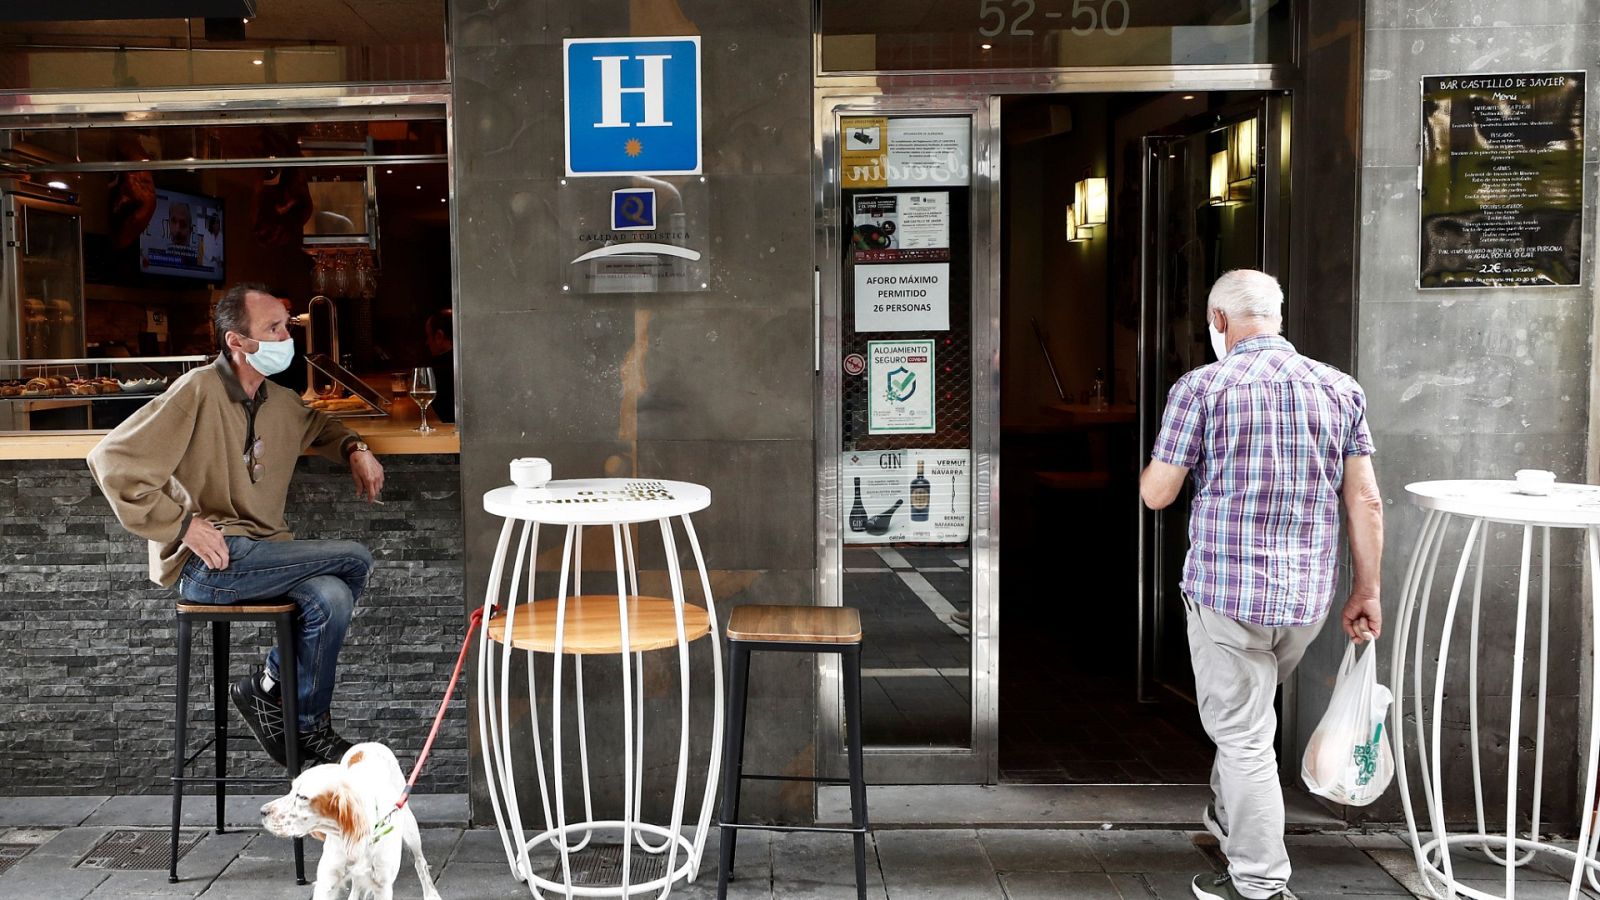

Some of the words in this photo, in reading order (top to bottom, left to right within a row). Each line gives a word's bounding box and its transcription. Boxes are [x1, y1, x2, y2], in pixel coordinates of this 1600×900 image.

[1440, 80, 1458, 90] BAR
[1461, 78, 1514, 89] CASTILLO
[1516, 78, 1527, 87] DE
[1530, 76, 1565, 87] JAVIER
[592, 54, 673, 128] H
[622, 196, 650, 225] Q
[579, 232, 626, 242] CALIDAD
[1478, 262, 1501, 273] 22€
[866, 276, 897, 285] AFORO
[899, 274, 938, 284] MÁXIMO
[878, 289, 927, 298] PERMITIDO
[873, 304, 884, 313] 26
[886, 303, 931, 312] PERSONAS
[873, 346, 928, 354] ALOJAMIENTO
[874, 356, 907, 364] SEGURO
[879, 453, 902, 470] GIN
